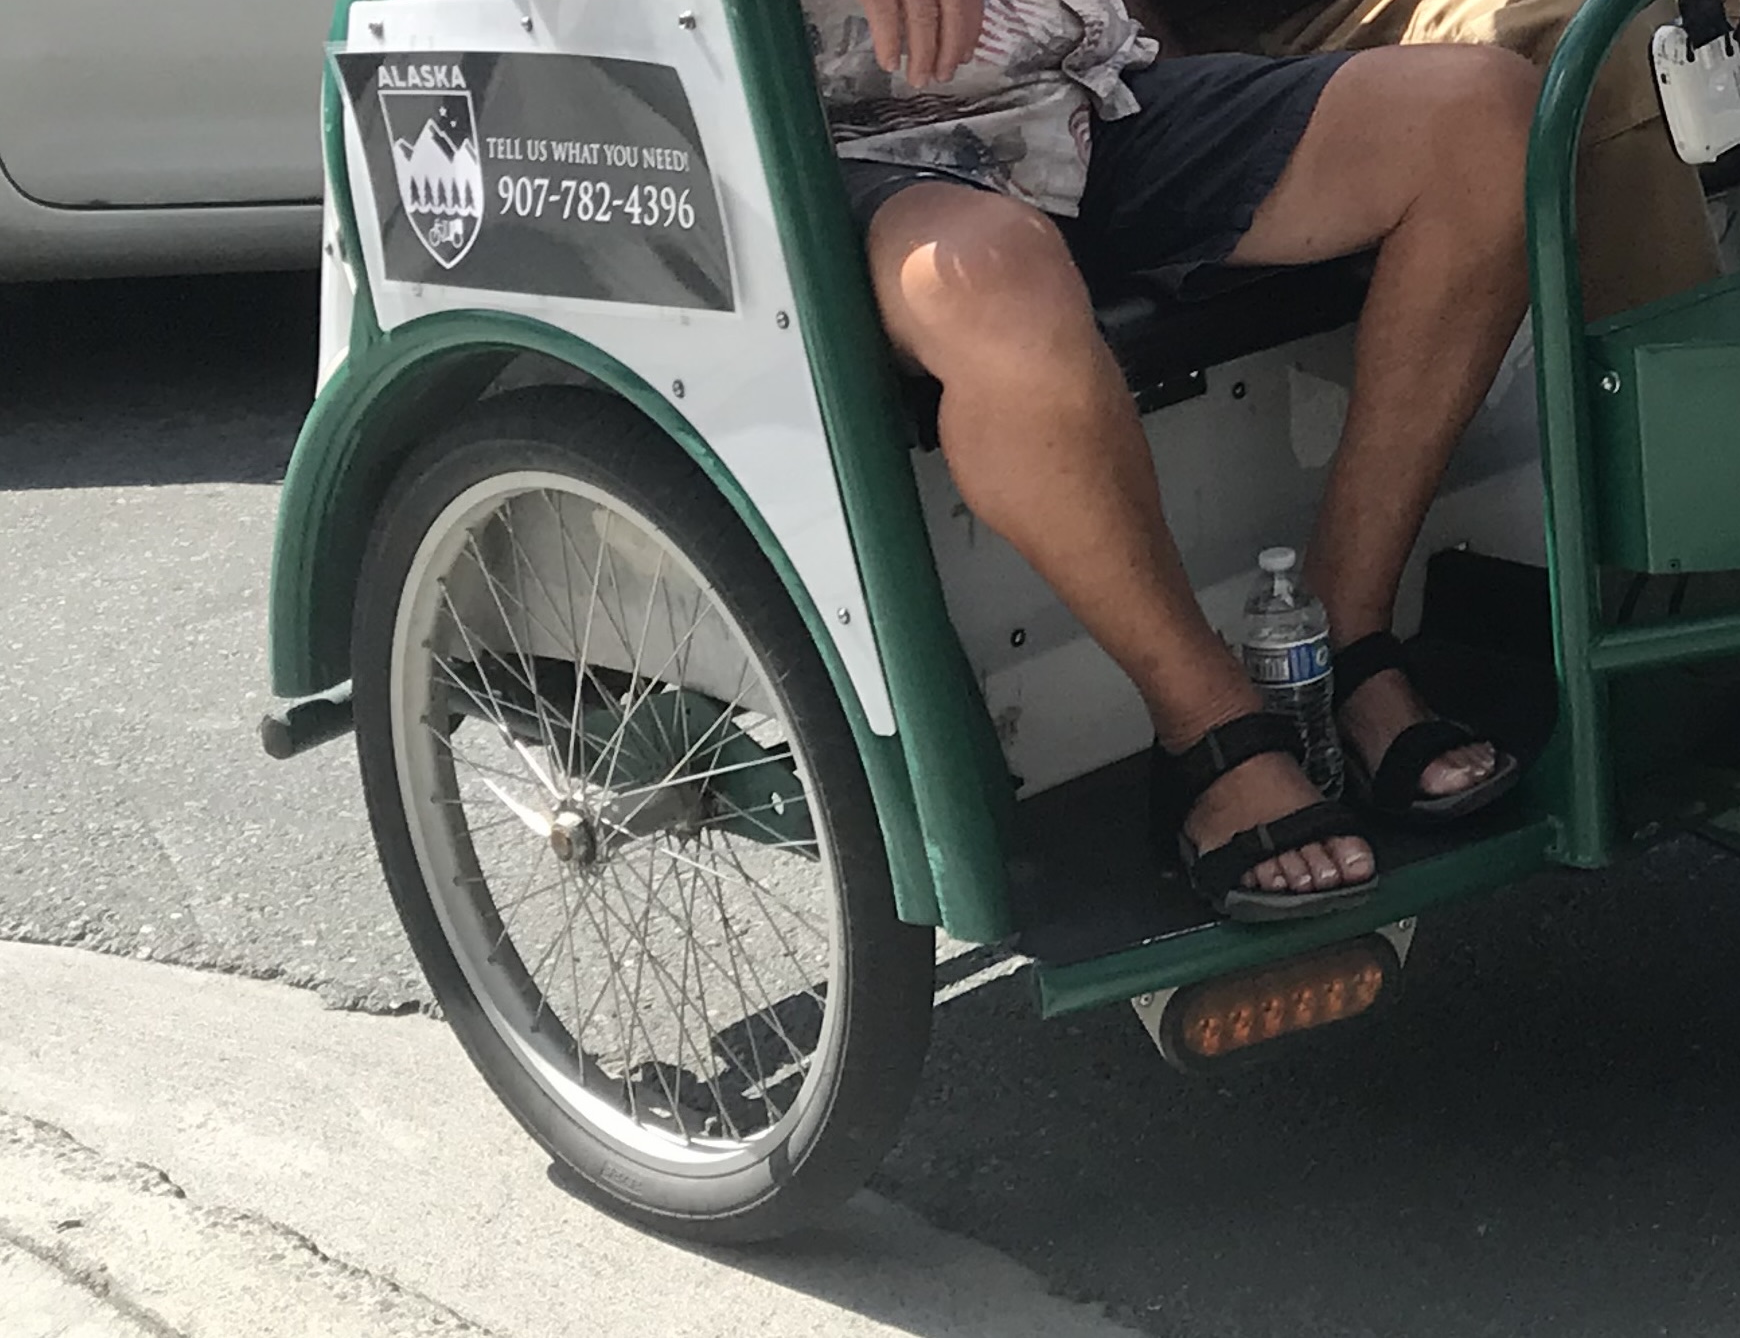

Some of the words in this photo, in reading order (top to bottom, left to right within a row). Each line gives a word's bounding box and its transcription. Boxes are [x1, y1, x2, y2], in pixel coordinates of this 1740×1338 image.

[378, 65, 467, 88] ALASKA
[486, 137, 523, 160] TELL
[527, 140, 548, 162] US
[550, 141, 600, 165] WHAT
[603, 144, 639, 168] YOU
[642, 148, 691, 171] NEED!
[498, 176, 696, 230] 907-782-4396
